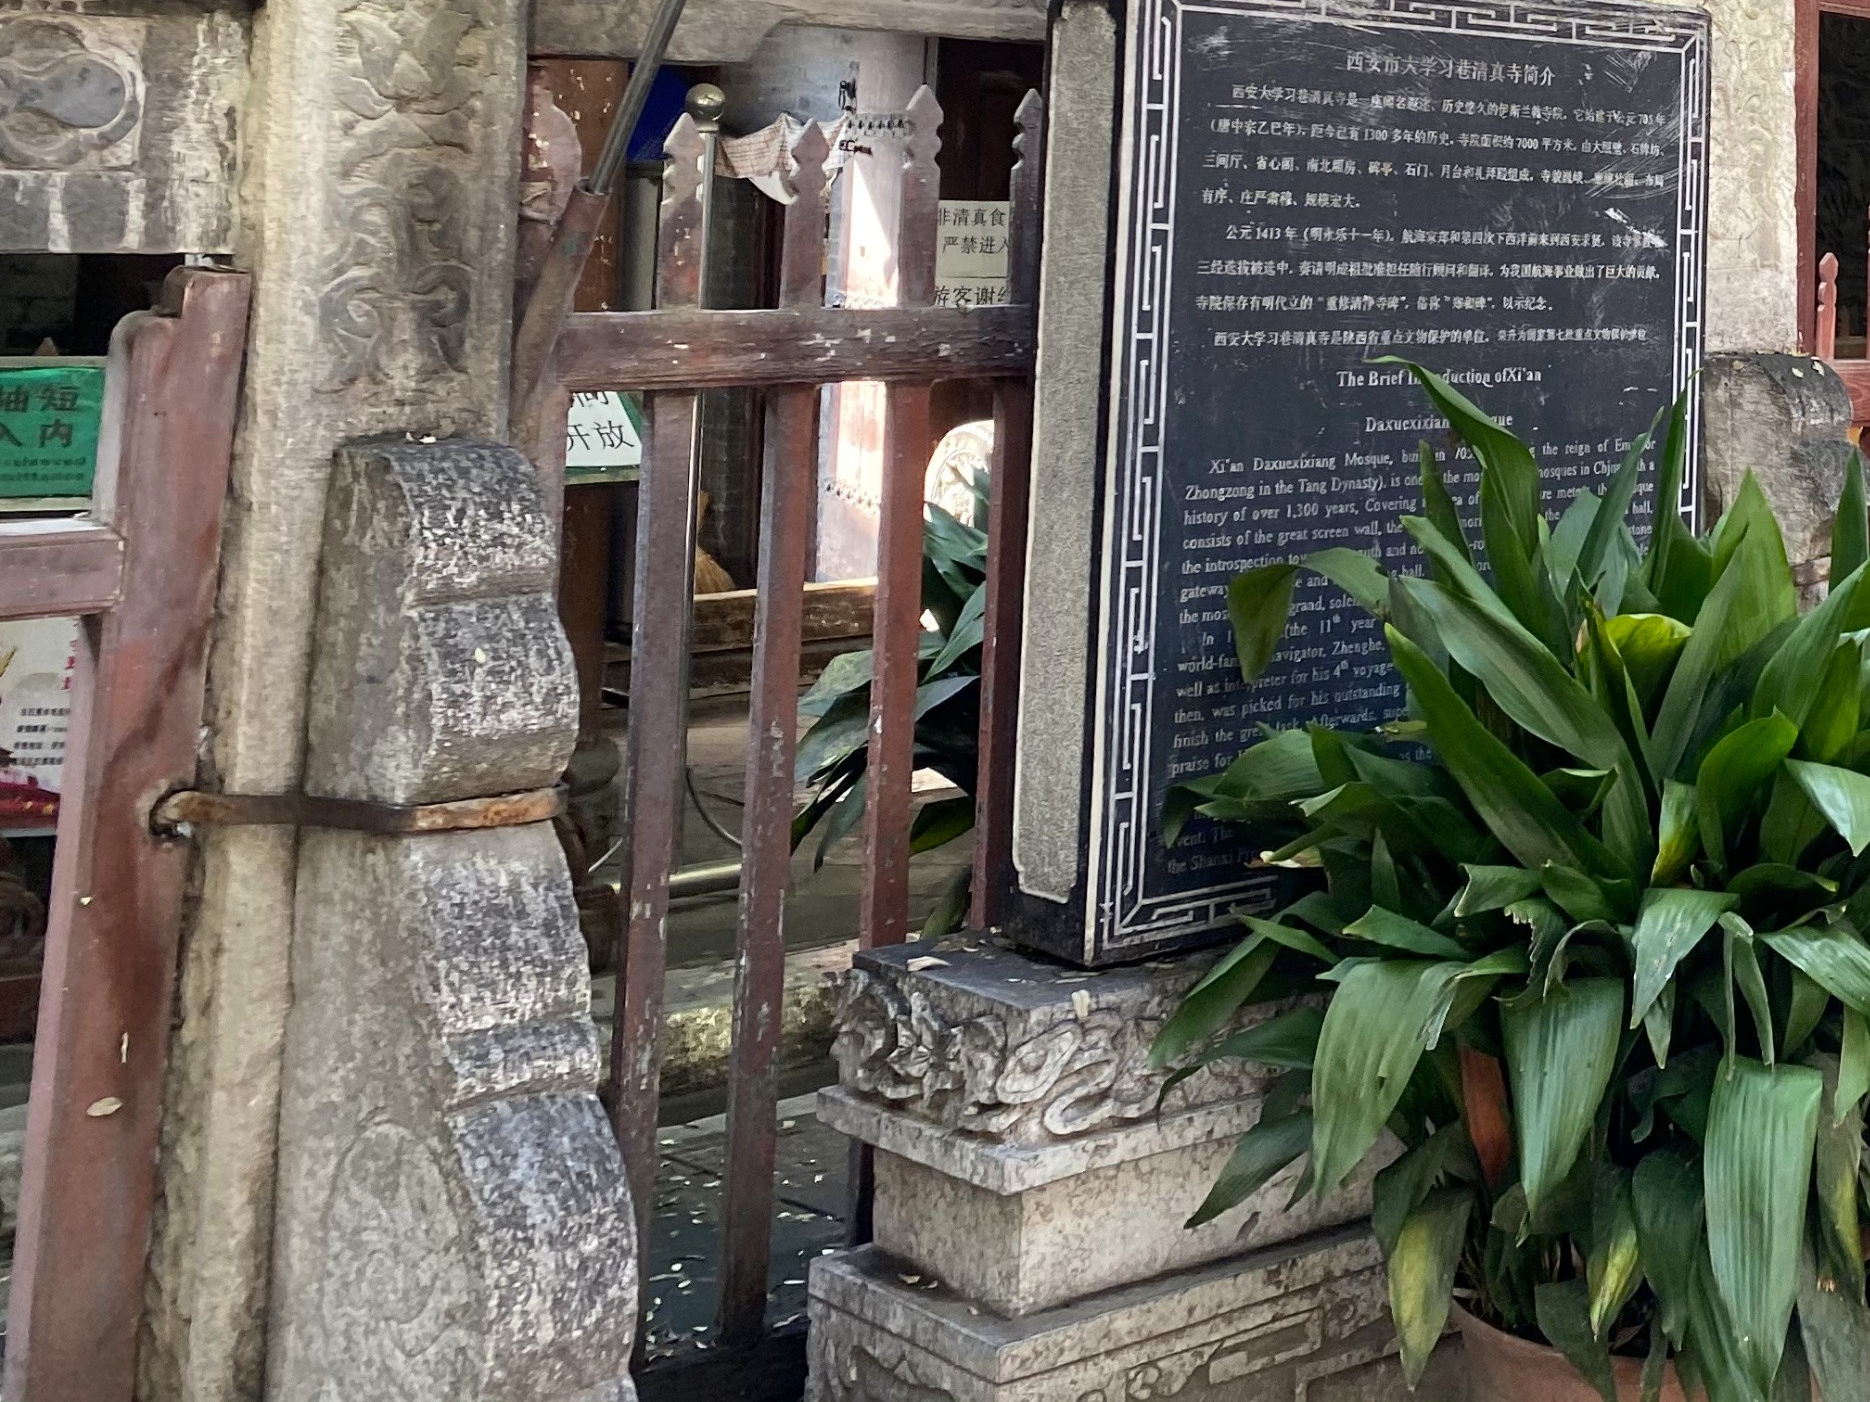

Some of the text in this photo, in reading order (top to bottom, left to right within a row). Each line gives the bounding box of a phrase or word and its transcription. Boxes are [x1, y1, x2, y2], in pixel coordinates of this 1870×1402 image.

[1347, 51, 1556, 86] 西安市大学习巷清真寺简介
[942, 235, 1010, 254] 严禁进入
[1336, 371, 1364, 387] The
[1367, 369, 1404, 387] Brief
[567, 420, 635, 453] 开放
[1365, 415, 1450, 433] Daxuexixian
[1252, 454, 1336, 473] Daxuexixiang
[1542, 442, 1558, 456] the
[1565, 440, 1591, 457] reign
[1597, 438, 1609, 453] of
[1614, 438, 1656, 452] Emor
[1184, 484, 1255, 502] Zhongzong
[1259, 482, 1271, 497] in
[1275, 479, 1294, 495] the
[1299, 477, 1328, 495] Tang
[1390, 474, 1401, 487] is
[1443, 469, 1460, 484] the
[1580, 461, 1590, 476] in
[1183, 509, 1228, 527] history
[1233, 507, 1249, 523] of
[1252, 507, 1280, 521] over
[1365, 495, 1417, 514] Covering
[1468, 491, 1480, 506] of
[1182, 534, 1232, 550] consists
[1236, 530, 1251, 546] of
[1254, 529, 1273, 544] the
[1278, 528, 1309, 547] great
[1312, 527, 1349, 541] screen
[1386, 521, 1404, 535] the
[1181, 559, 1202, 575] the
[1205, 554, 1285, 574] introspection
[1386, 544, 1406, 557] and
[1306, 574, 1329, 589] and
[1179, 610, 1200, 625] the
[1202, 632, 1214, 646] In
[1350, 618, 1376, 634] year
[1176, 683, 1203, 698] well
[1290, 668, 1307, 685] for
[1311, 666, 1330, 682] his
[1353, 661, 1394, 678] voyage
[1212, 704, 1236, 718] was
[1241, 697, 1282, 719] picked
[1287, 694, 1306, 710] for
[1311, 690, 1330, 706] his
[1333, 682, 1401, 705] outstanding
[1173, 728, 1209, 748] finish
[1214, 726, 1234, 743] the
[1170, 756, 1210, 778] praise
[1214, 750, 1233, 768] for
